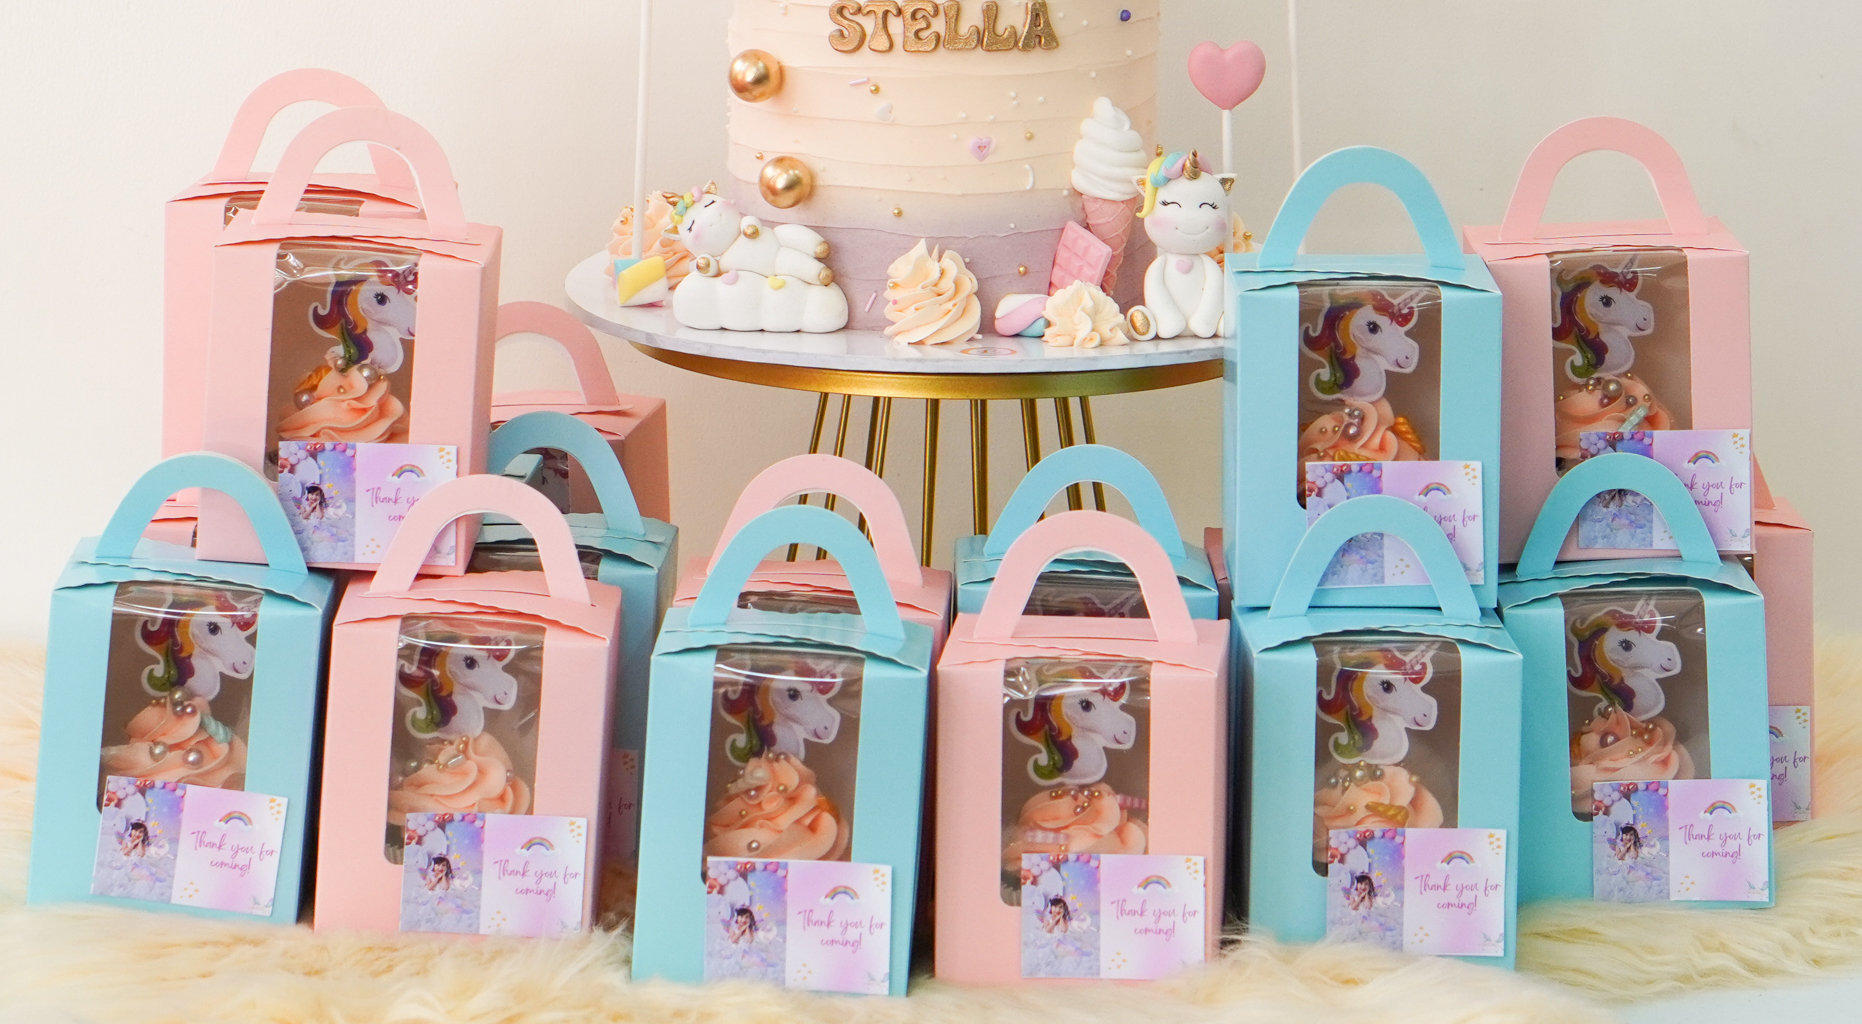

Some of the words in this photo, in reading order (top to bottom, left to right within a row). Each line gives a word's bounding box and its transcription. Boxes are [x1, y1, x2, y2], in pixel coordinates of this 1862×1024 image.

[365, 487, 402, 507] Thank
[1702, 481, 1725, 497] you
[1729, 476, 1746, 495] for
[1694, 492, 1723, 513] ming!
[1462, 508, 1480, 528] for
[1793, 750, 1810, 769] for
[190, 830, 226, 851] Thank
[230, 844, 255, 859] you
[259, 842, 277, 861] for
[1678, 823, 1715, 845] Thank
[1719, 832, 1744, 848] you
[1747, 827, 1765, 846] for
[1701, 843, 1741, 864] coming!
[210, 857, 252, 877] coming!
[493, 859, 530, 880] Thank
[534, 870, 559, 885] you
[563, 866, 581, 885] for
[515, 881, 557, 902] coming!
[1414, 874, 1451, 895] Thank
[1455, 883, 1479, 899] you
[1484, 878, 1501, 897] for
[1111, 899, 1148, 920] Thank
[1152, 908, 1178, 925] you
[1182, 903, 1200, 923] for
[1436, 894, 1477, 916] coming!
[797, 909, 835, 931] Thank
[840, 920, 864, 936] you
[869, 915, 887, 936] for
[1134, 920, 1176, 942] coming!
[820, 932, 862, 954] coming!
